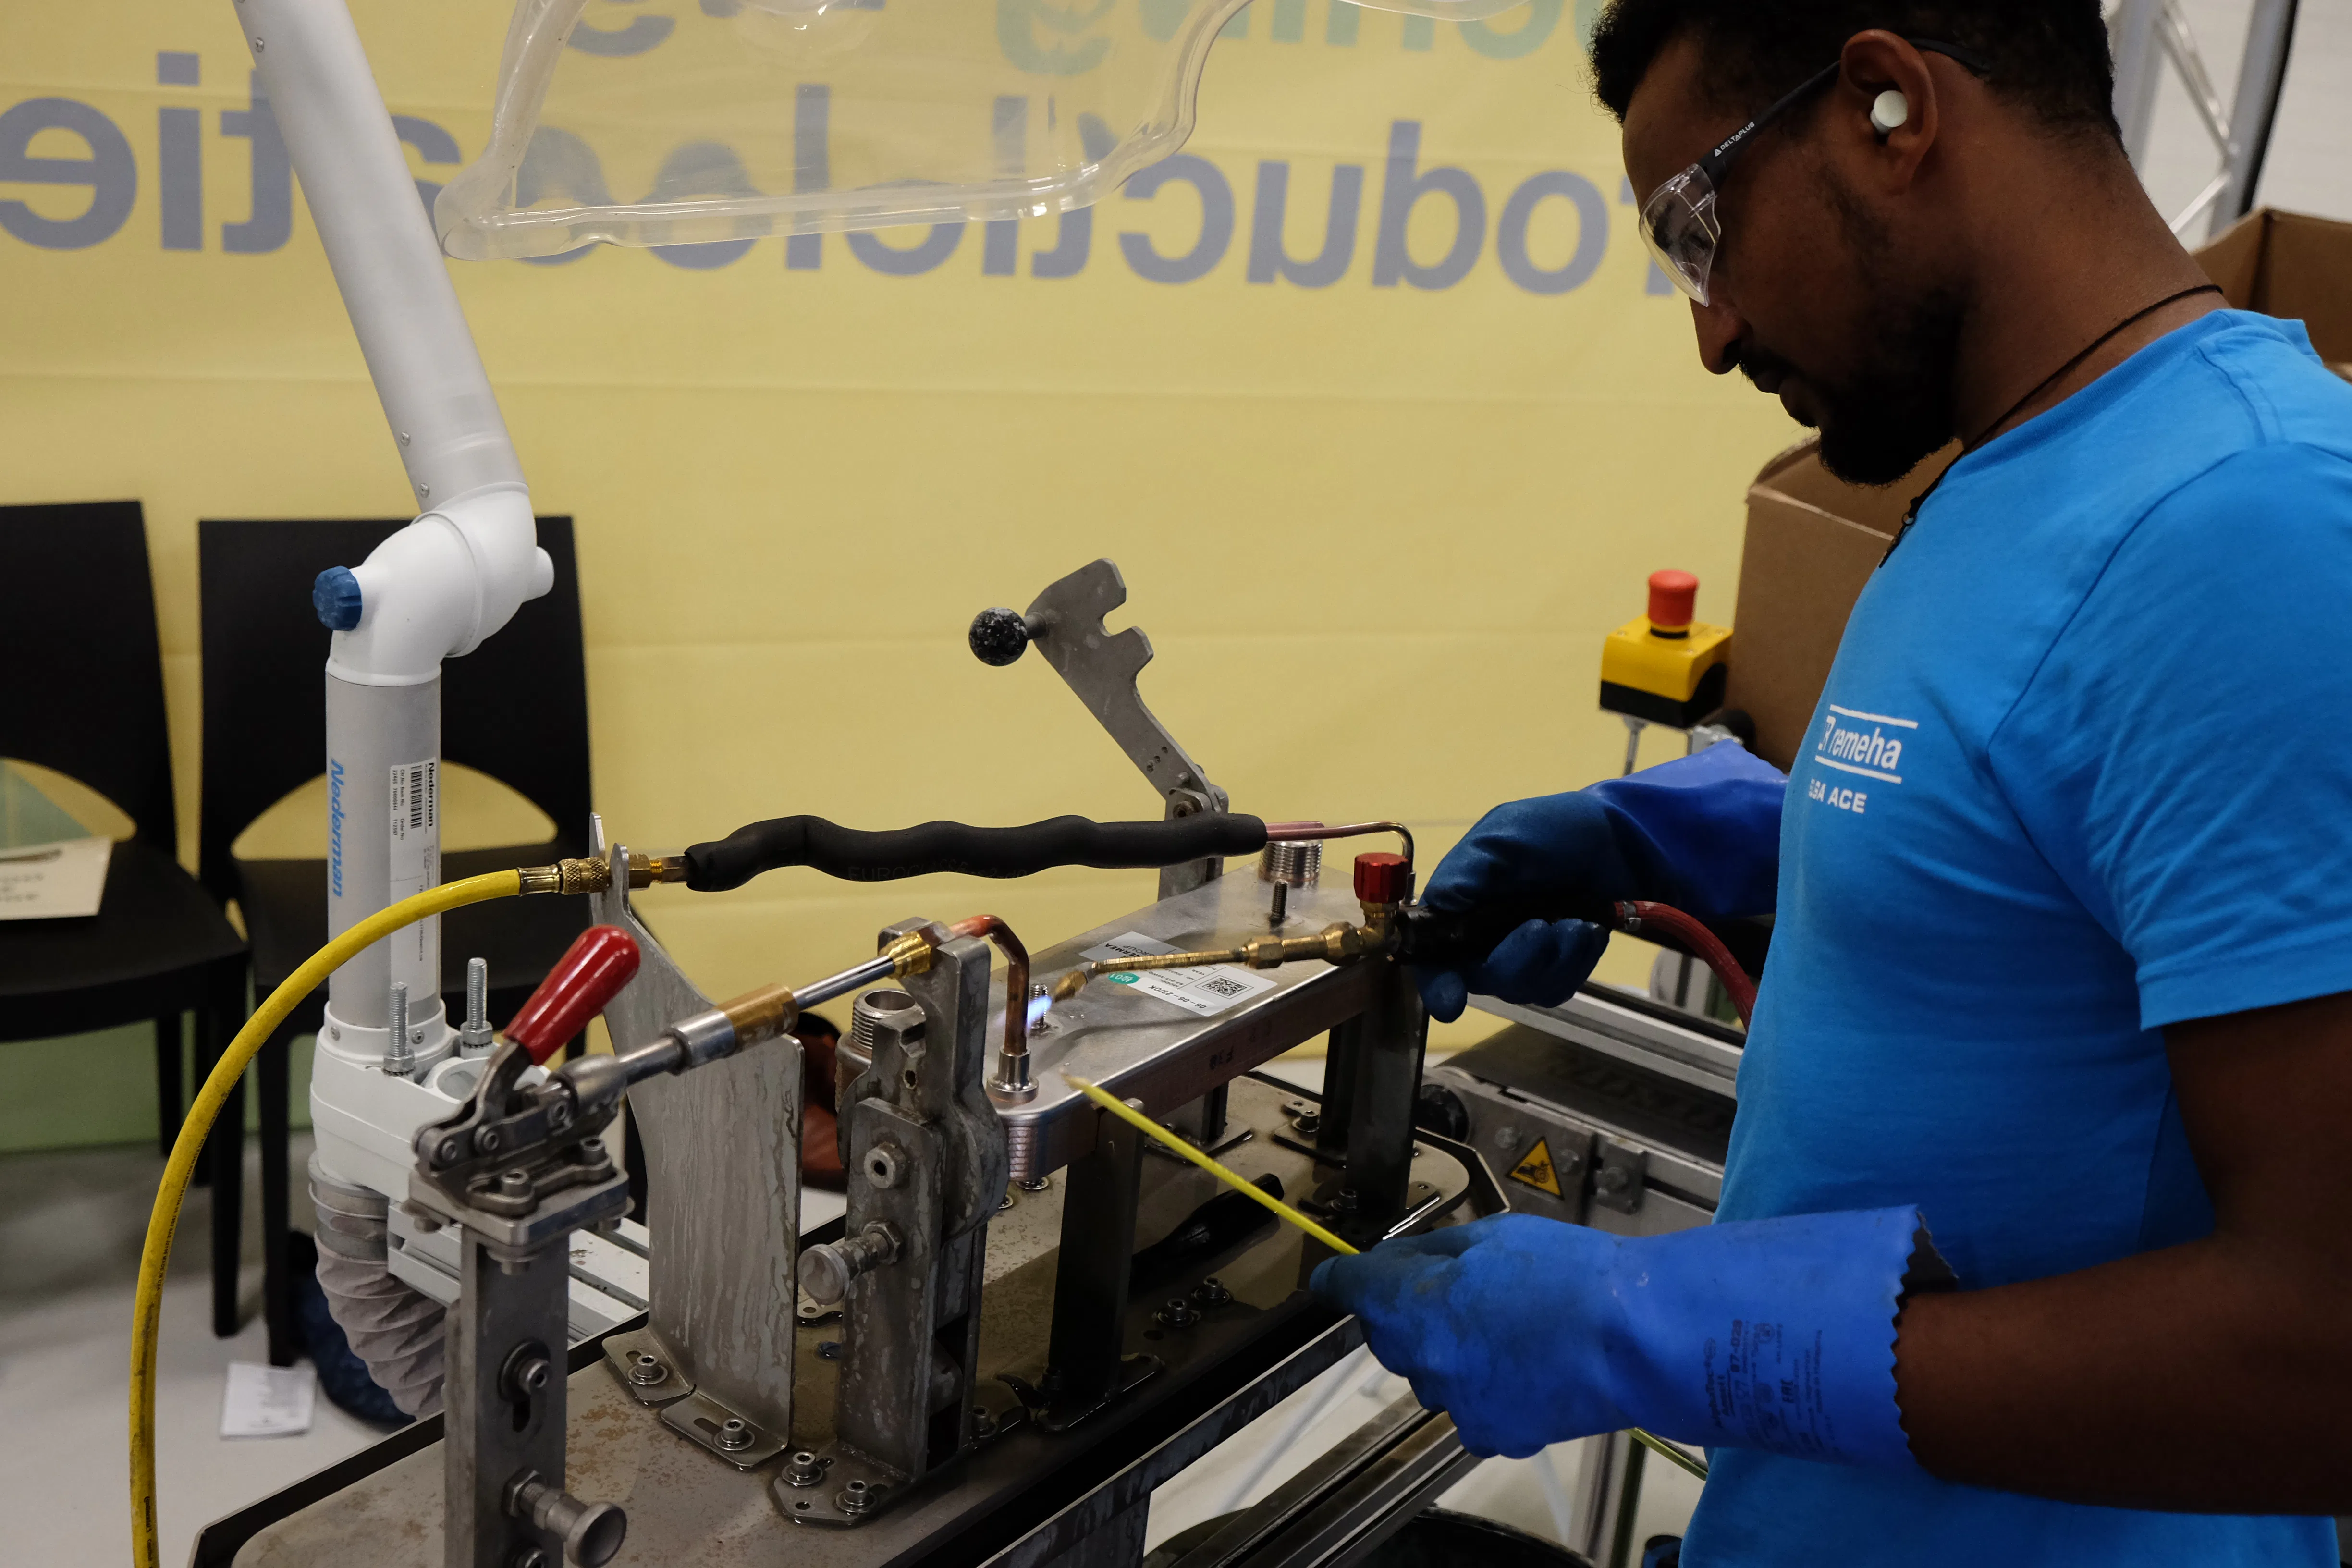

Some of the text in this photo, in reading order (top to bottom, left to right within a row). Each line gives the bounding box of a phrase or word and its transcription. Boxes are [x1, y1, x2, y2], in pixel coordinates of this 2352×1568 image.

[1720, 122, 1755, 150] DELTAPLUS
[1827, 727, 1902, 770] remeha
[1827, 786, 1868, 814] ACE
[331, 758, 345, 898] Nederman
[1105, 943, 1139, 957] ERMEA
